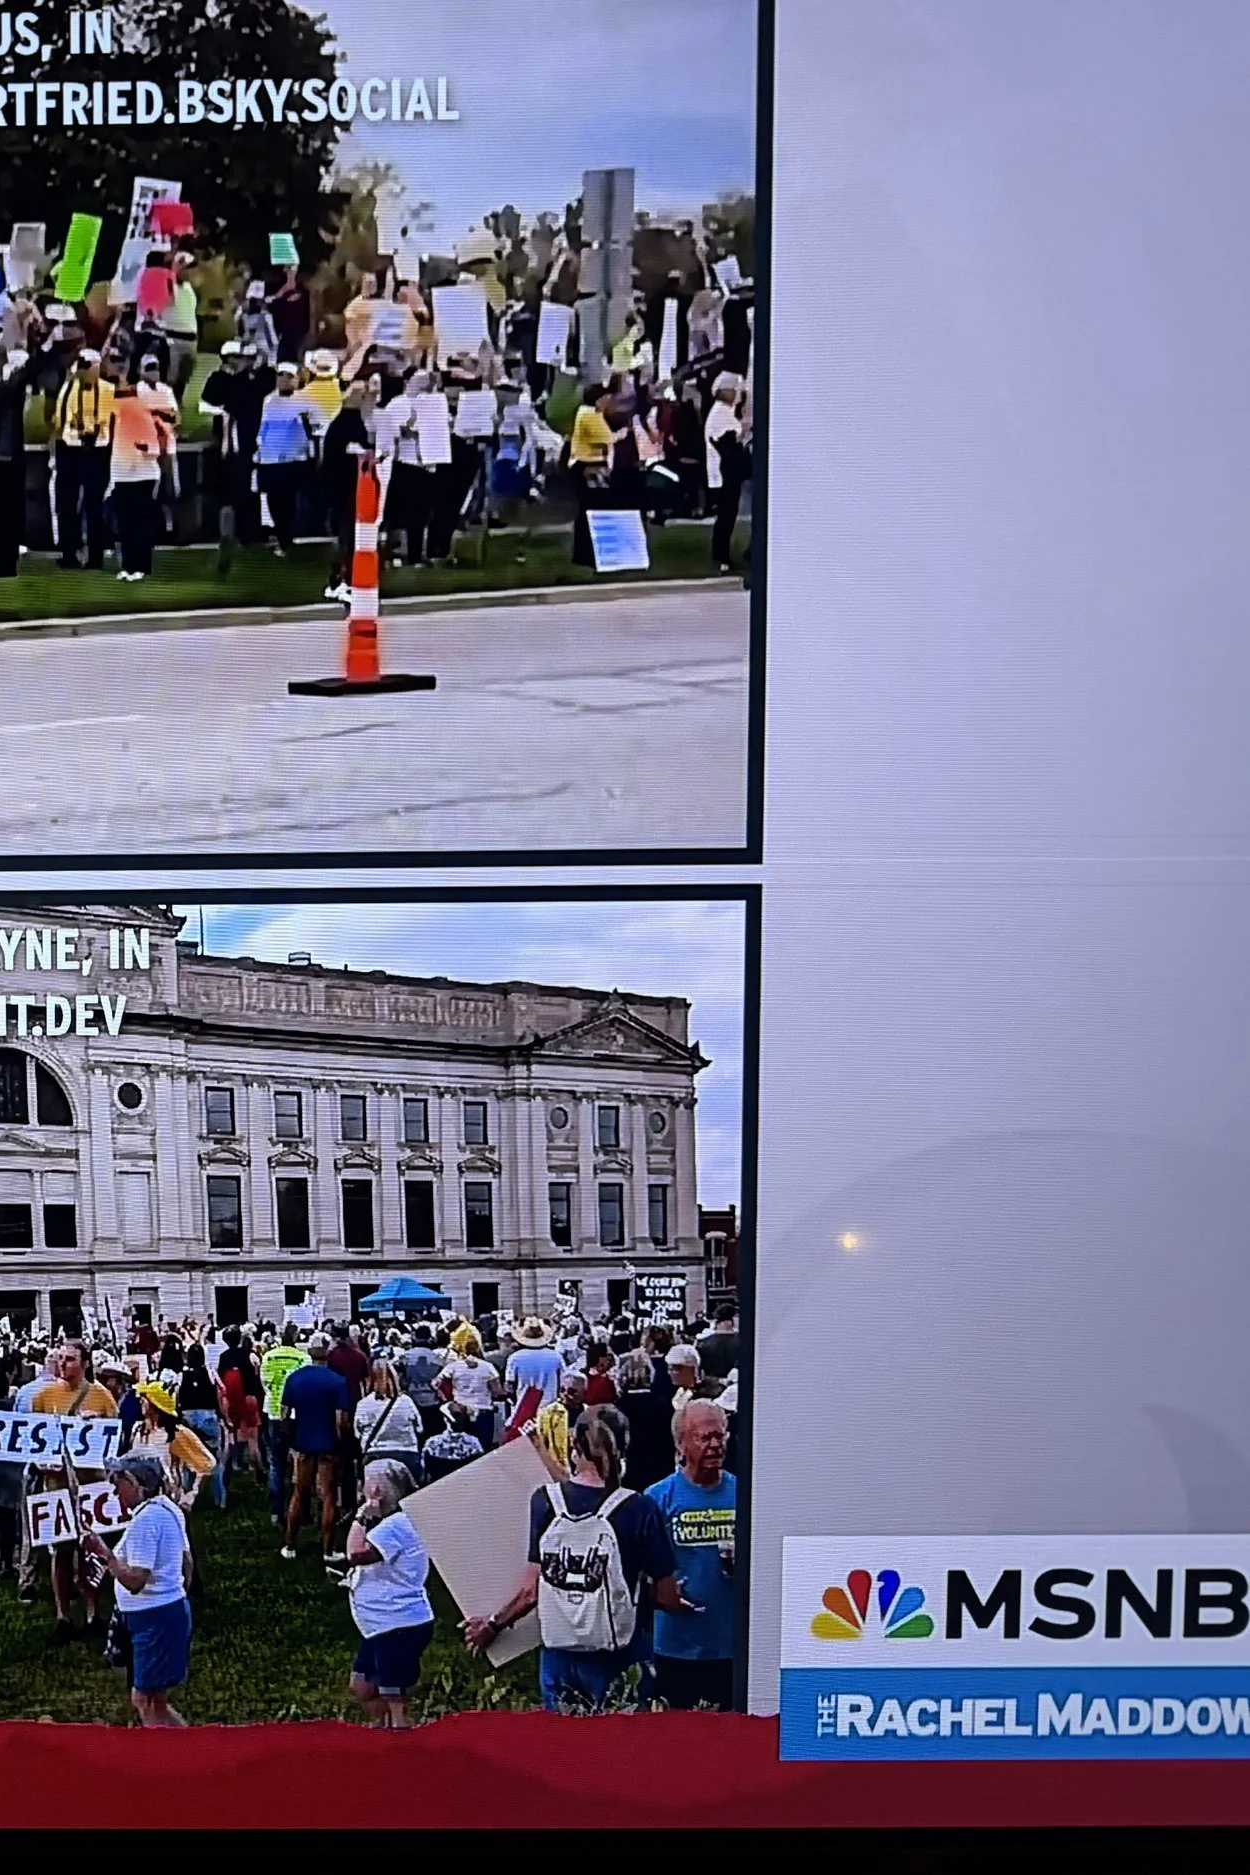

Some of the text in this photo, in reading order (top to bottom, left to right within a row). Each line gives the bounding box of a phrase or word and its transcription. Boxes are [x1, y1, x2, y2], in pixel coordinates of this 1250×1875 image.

[69, 10, 112, 55] IN
[109, 928, 150, 971] IN
[31, 1492, 134, 1541] FASCI
[945, 1568, 1250, 1640] MSNB
[816, 1692, 836, 1738] THE
[836, 1693, 1033, 1738] RACHEL
